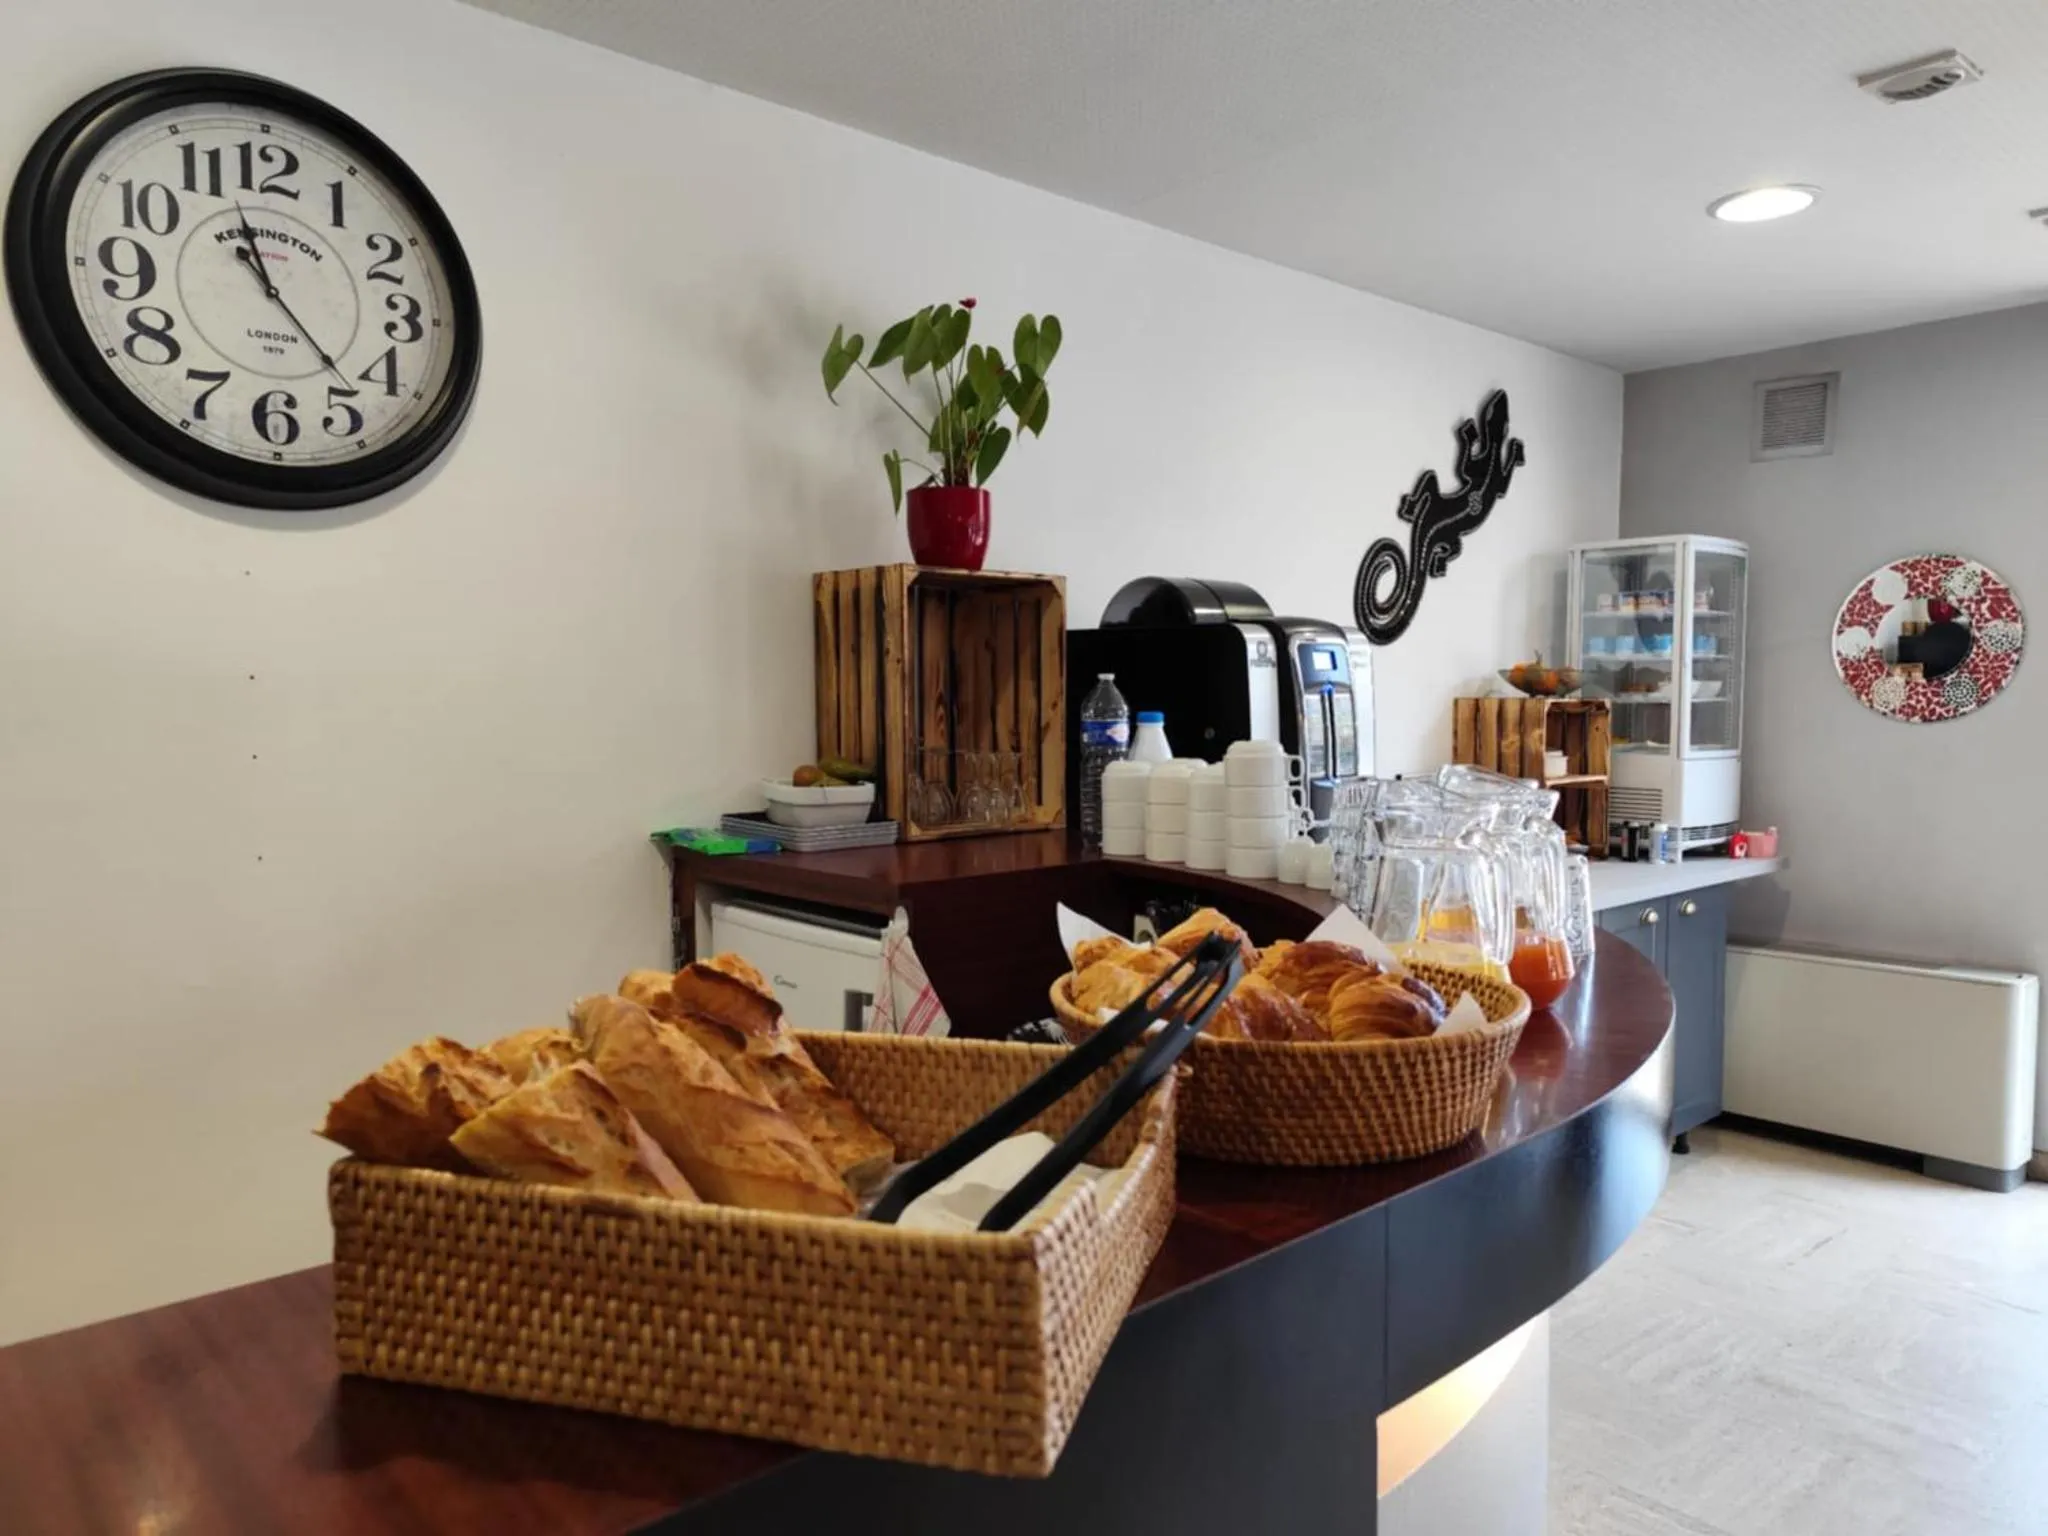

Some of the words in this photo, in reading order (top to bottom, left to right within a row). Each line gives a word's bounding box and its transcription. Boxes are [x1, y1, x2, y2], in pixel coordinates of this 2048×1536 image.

[176, 141, 226, 198] 11
[232, 141, 301, 200] 12
[117, 179, 181, 236] 10
[326, 180, 348, 229] 1
[97, 236, 157, 301] 9
[365, 233, 405, 285] 2
[122, 306, 182, 365] 8
[247, 328, 298, 344] LONDON
[383, 293, 424, 343] 3
[185, 368, 231, 421] 7
[357, 345, 407, 397] 4
[251, 390, 300, 446] 6
[322, 385, 364, 437] 5
